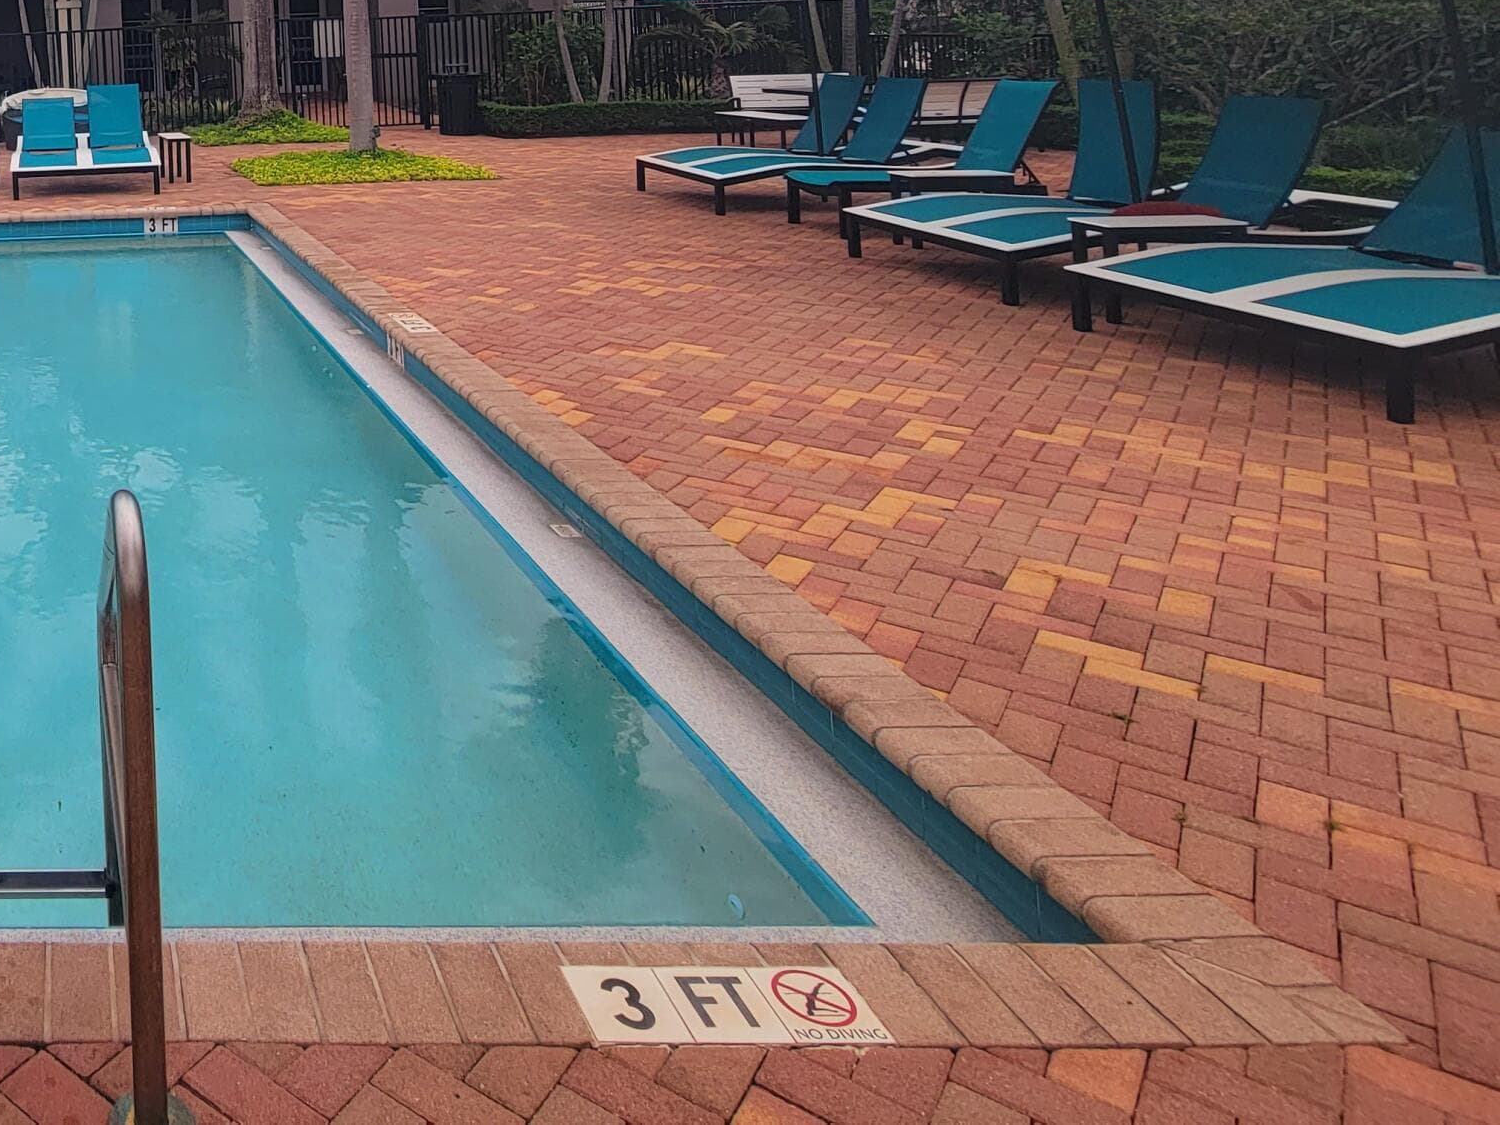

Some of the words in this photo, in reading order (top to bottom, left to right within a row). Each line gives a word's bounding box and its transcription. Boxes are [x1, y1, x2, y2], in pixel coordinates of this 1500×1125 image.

[149, 217, 156, 232] 3
[162, 217, 177, 232] FT
[600, 977, 656, 1031] 3
[673, 975, 762, 1028] FT
[794, 1028, 823, 1040] NO
[826, 1028, 888, 1040] DIVING
